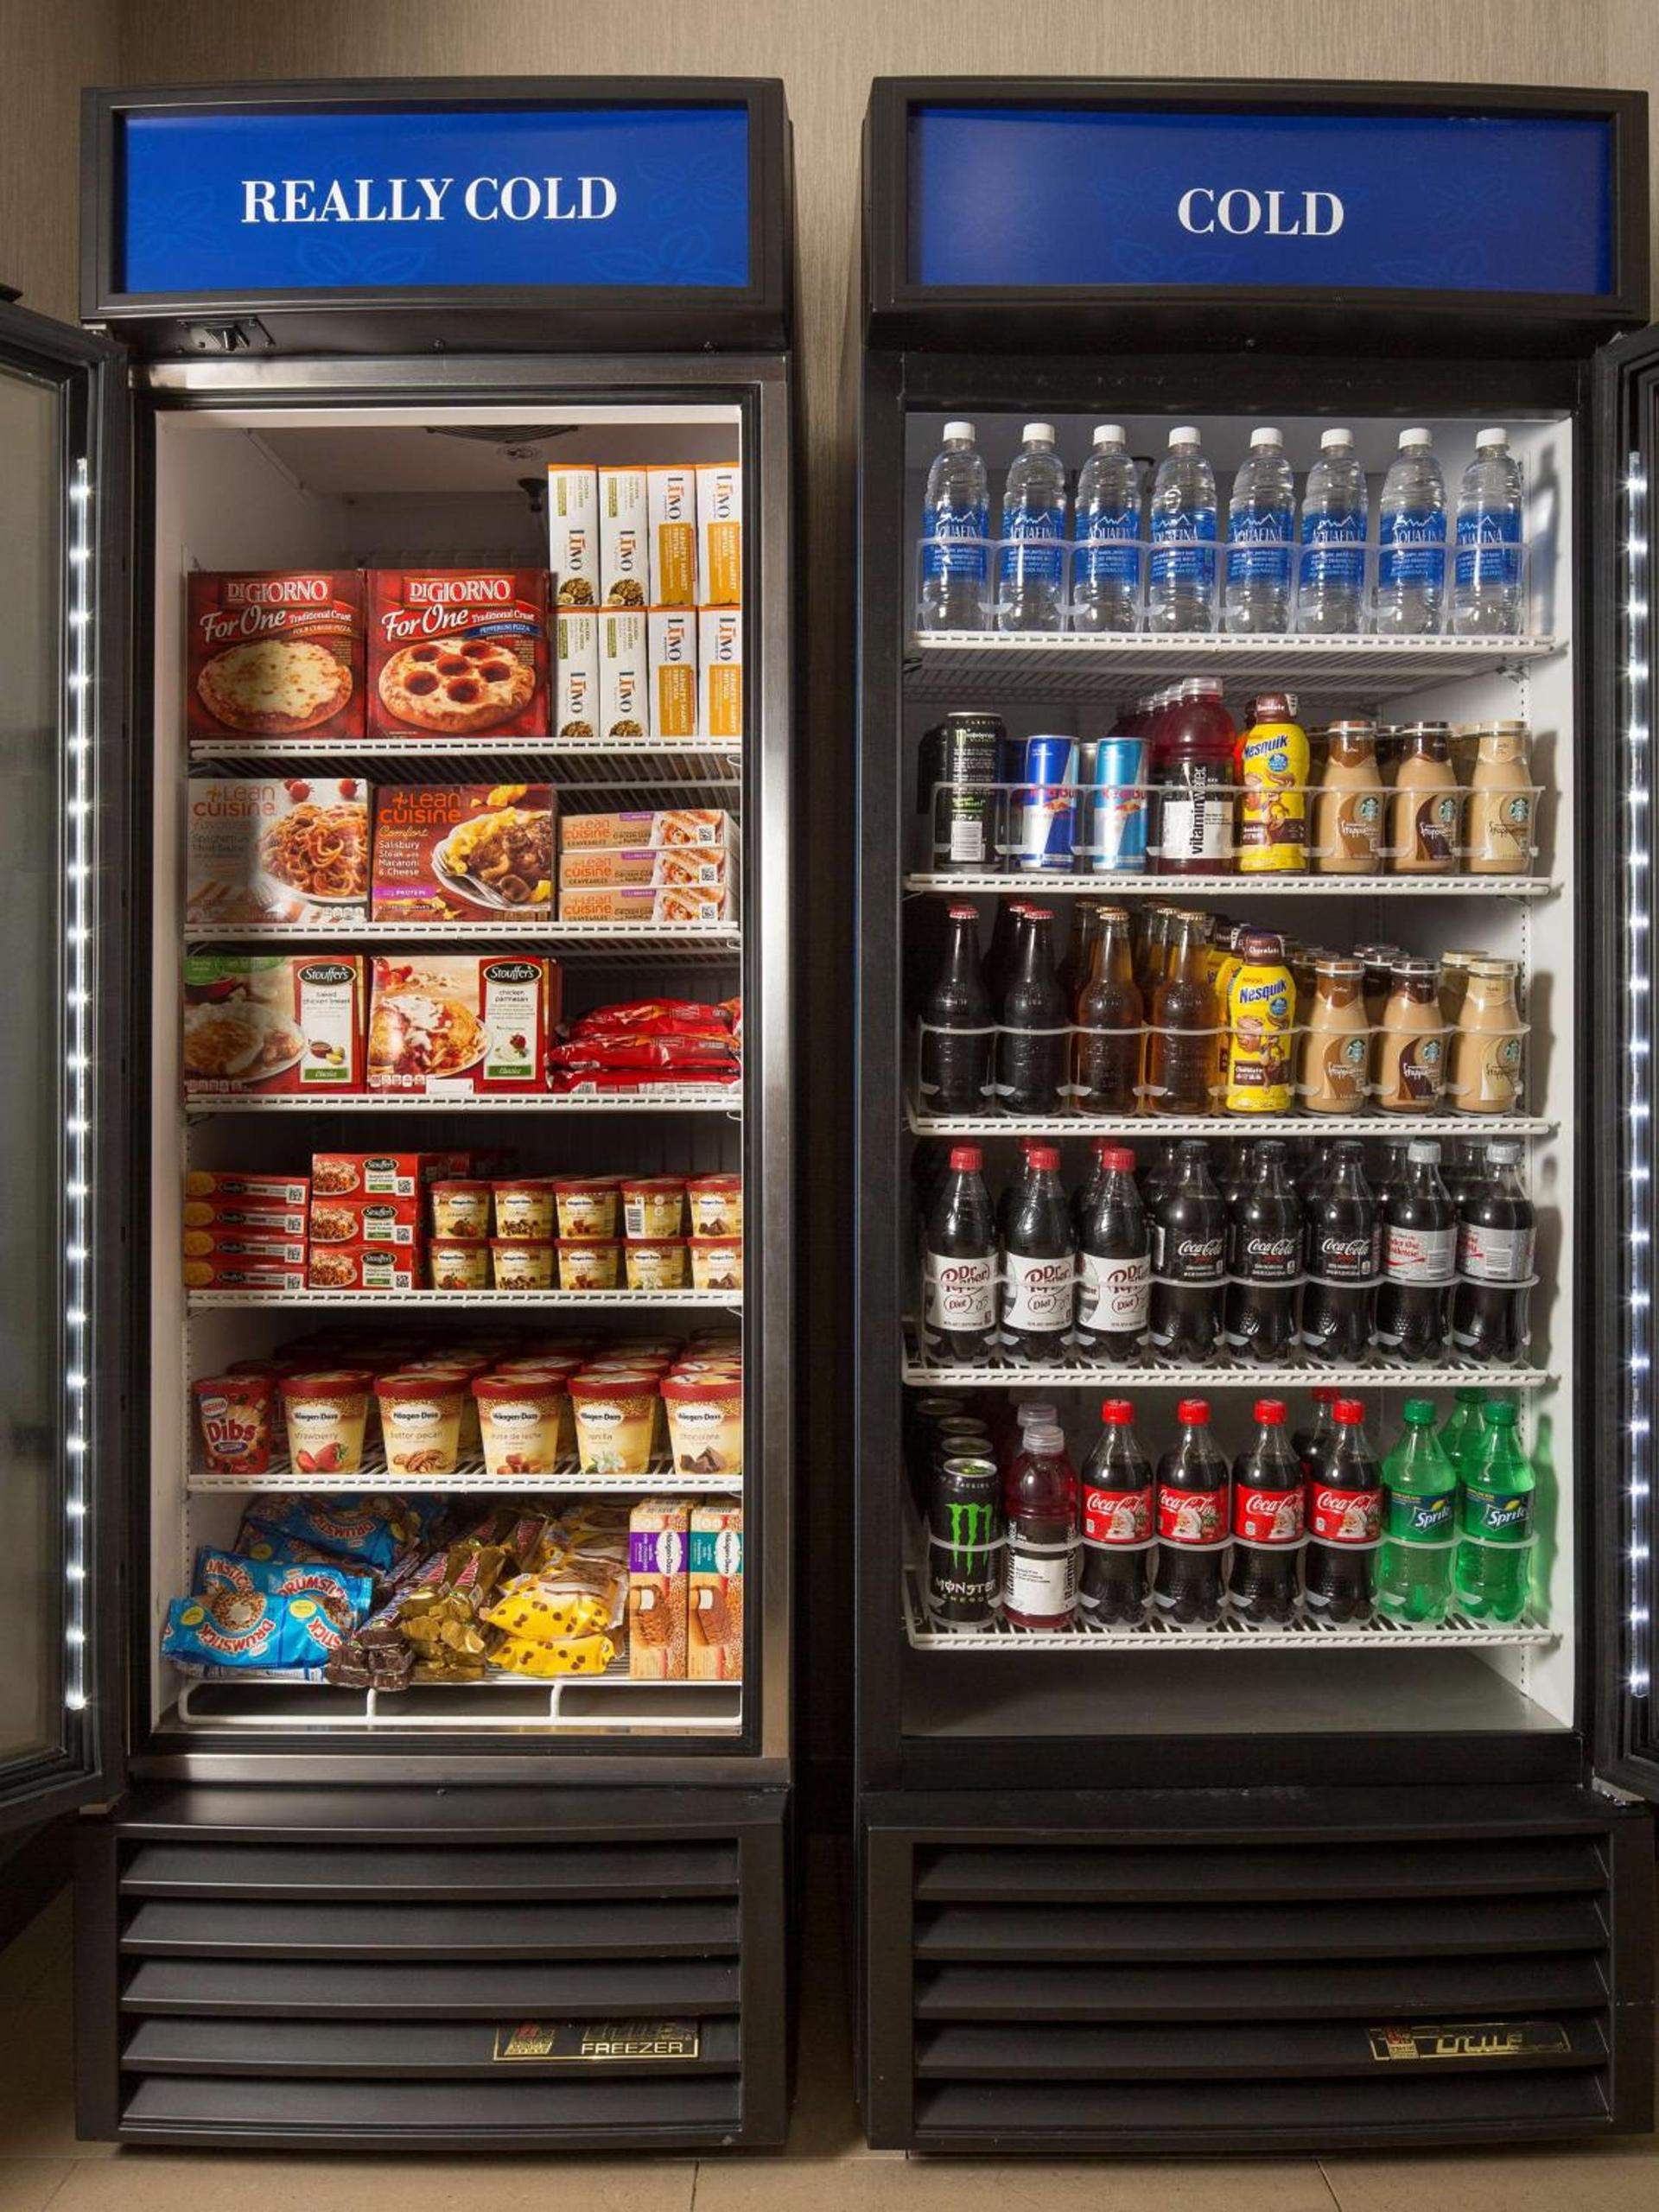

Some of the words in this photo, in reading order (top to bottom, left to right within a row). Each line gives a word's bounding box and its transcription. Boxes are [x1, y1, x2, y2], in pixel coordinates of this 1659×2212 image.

[241, 178, 454, 223] REALLY
[464, 176, 617, 220] COLD
[1177, 188, 1344, 236] COLD
[200, 611, 238, 643] For
[240, 606, 286, 635] One
[289, 610, 330, 624] Traditional
[331, 609, 353, 622] Crust
[381, 609, 420, 641] For
[422, 604, 469, 633] One
[472, 610, 513, 623] Traditional
[514, 609, 534, 620] Crust
[512, 624, 531, 632] PIZZA
[378, 825, 429, 838] Comfort
[378, 840, 420, 851] Salisbury
[378, 858, 420, 868] Macaroni
[386, 867, 420, 876] Cheese
[305, 966, 349, 982] Stouffer's
[490, 965, 535, 980] Stouffer's
[1239, 979, 1287, 1003] Nesquik
[1247, 1237, 1295, 1255] Coca-Cola
[1322, 1237, 1371, 1255] Coca-Cola
[958, 1266, 977, 1279] Dr
[1043, 1265, 1062, 1280] Dr
[1127, 1265, 1144, 1280] Dr
[949, 1300, 967, 1310] Diet
[1033, 1299, 1051, 1311] Diet
[1117, 1299, 1134, 1312] Diet
[207, 1419, 256, 1442] Dibs
[416, 1432, 443, 1441] pecan
[1415, 1506, 1452, 1528] Sprite
[1487, 1508, 1528, 1528] Sprite
[195, 1618, 276, 1656] DRUMSTICK
[581, 2041, 683, 2055] FREEZER
